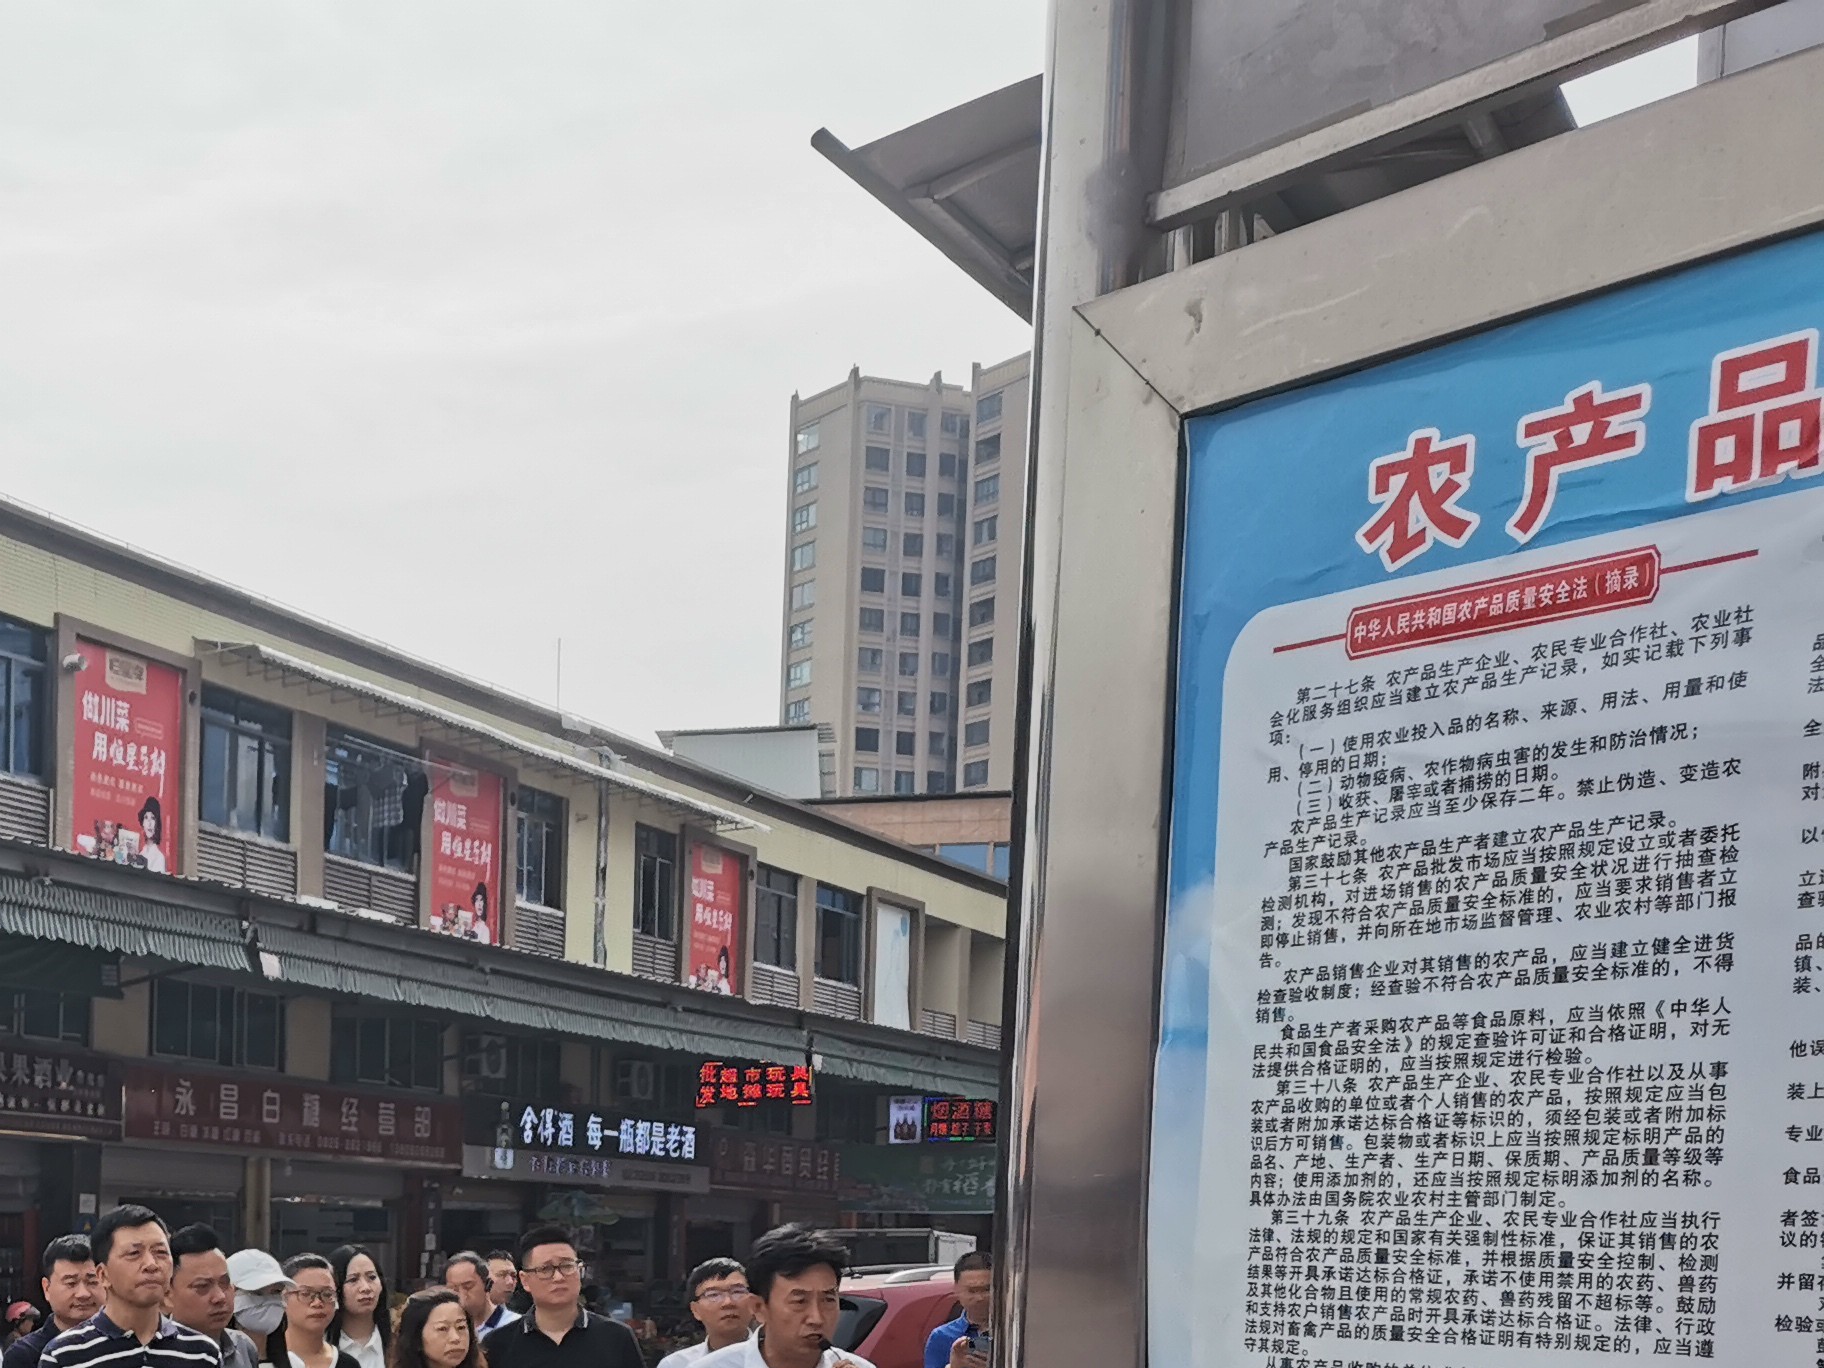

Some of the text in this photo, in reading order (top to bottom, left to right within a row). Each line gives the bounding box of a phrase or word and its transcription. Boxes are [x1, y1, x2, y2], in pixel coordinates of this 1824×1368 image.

[1357, 329, 1824, 571] 农产品
[1353, 566, 1653, 643] 中华人民共和国农产品质量安全法（摘录）
[1294, 673, 1376, 705] 第二十七条
[1267, 727, 1291, 747] 项：
[1265, 749, 1386, 784] 用、停用的日期；
[1802, 761, 1824, 780] 附
[1802, 782, 1824, 801] 对
[1262, 828, 1367, 857] 产品生产记录。
[1801, 826, 1824, 844] 以
[1286, 865, 1368, 892] 第三十七条
[1257, 950, 1282, 969] 告。
[1254, 1005, 1295, 1025] 销售。
[1274, 1075, 1357, 1096] 第三十八条
[174, 1079, 432, 1138] 永昌白糖经营部
[519, 1105, 696, 1160] 舍得酒 每一瓶都是老酒
[1784, 1124, 1824, 1143] 专业
[1269, 1207, 1350, 1226] 第三十九条
[1780, 1209, 1824, 1228] 者签
[1779, 1231, 1824, 1249] 议的
[1242, 1335, 1309, 1356] 守其规定。
